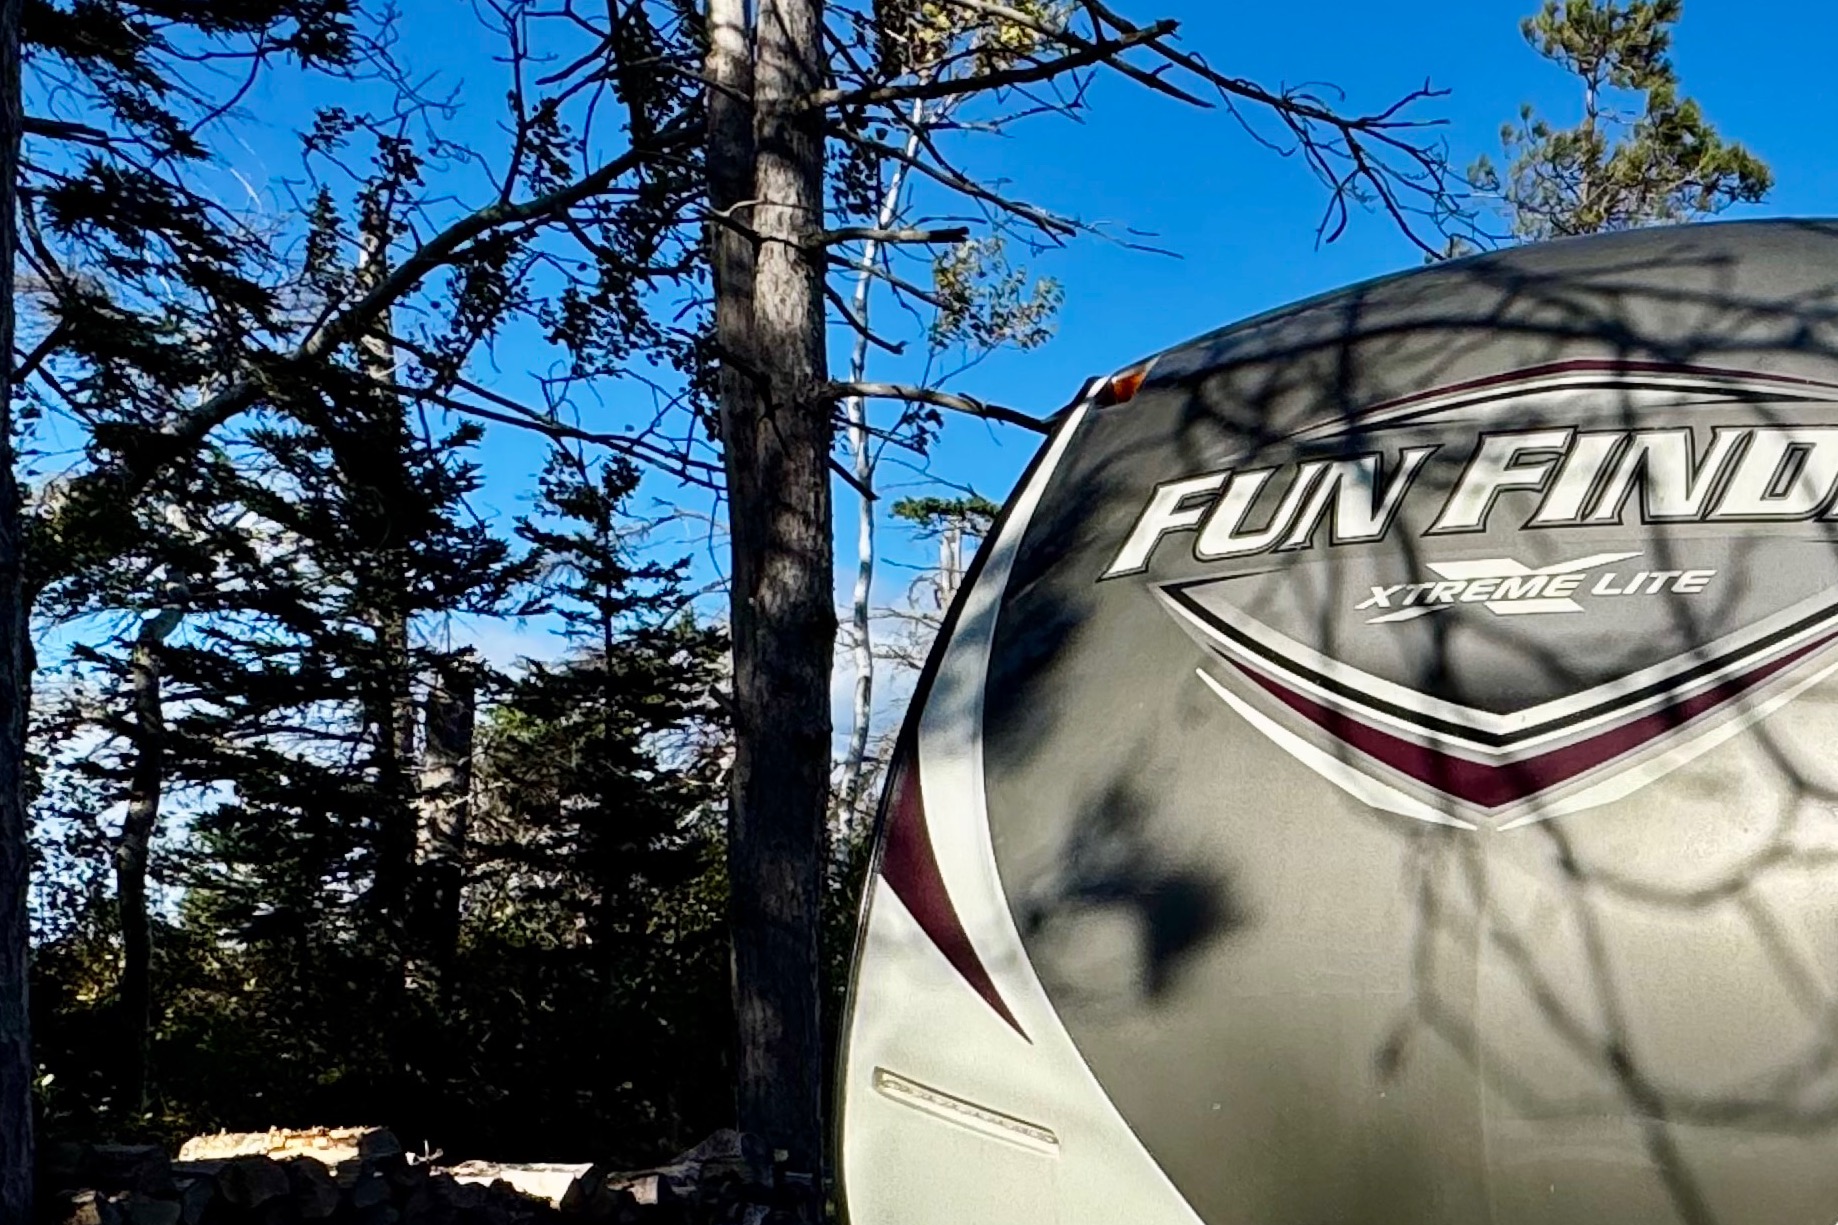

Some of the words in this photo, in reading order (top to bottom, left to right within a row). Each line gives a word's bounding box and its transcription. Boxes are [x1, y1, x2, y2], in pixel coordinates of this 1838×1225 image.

[1097, 445, 1443, 581] FUN
[1354, 573, 1586, 610] XTREME
[1591, 569, 1717, 596] LITE
